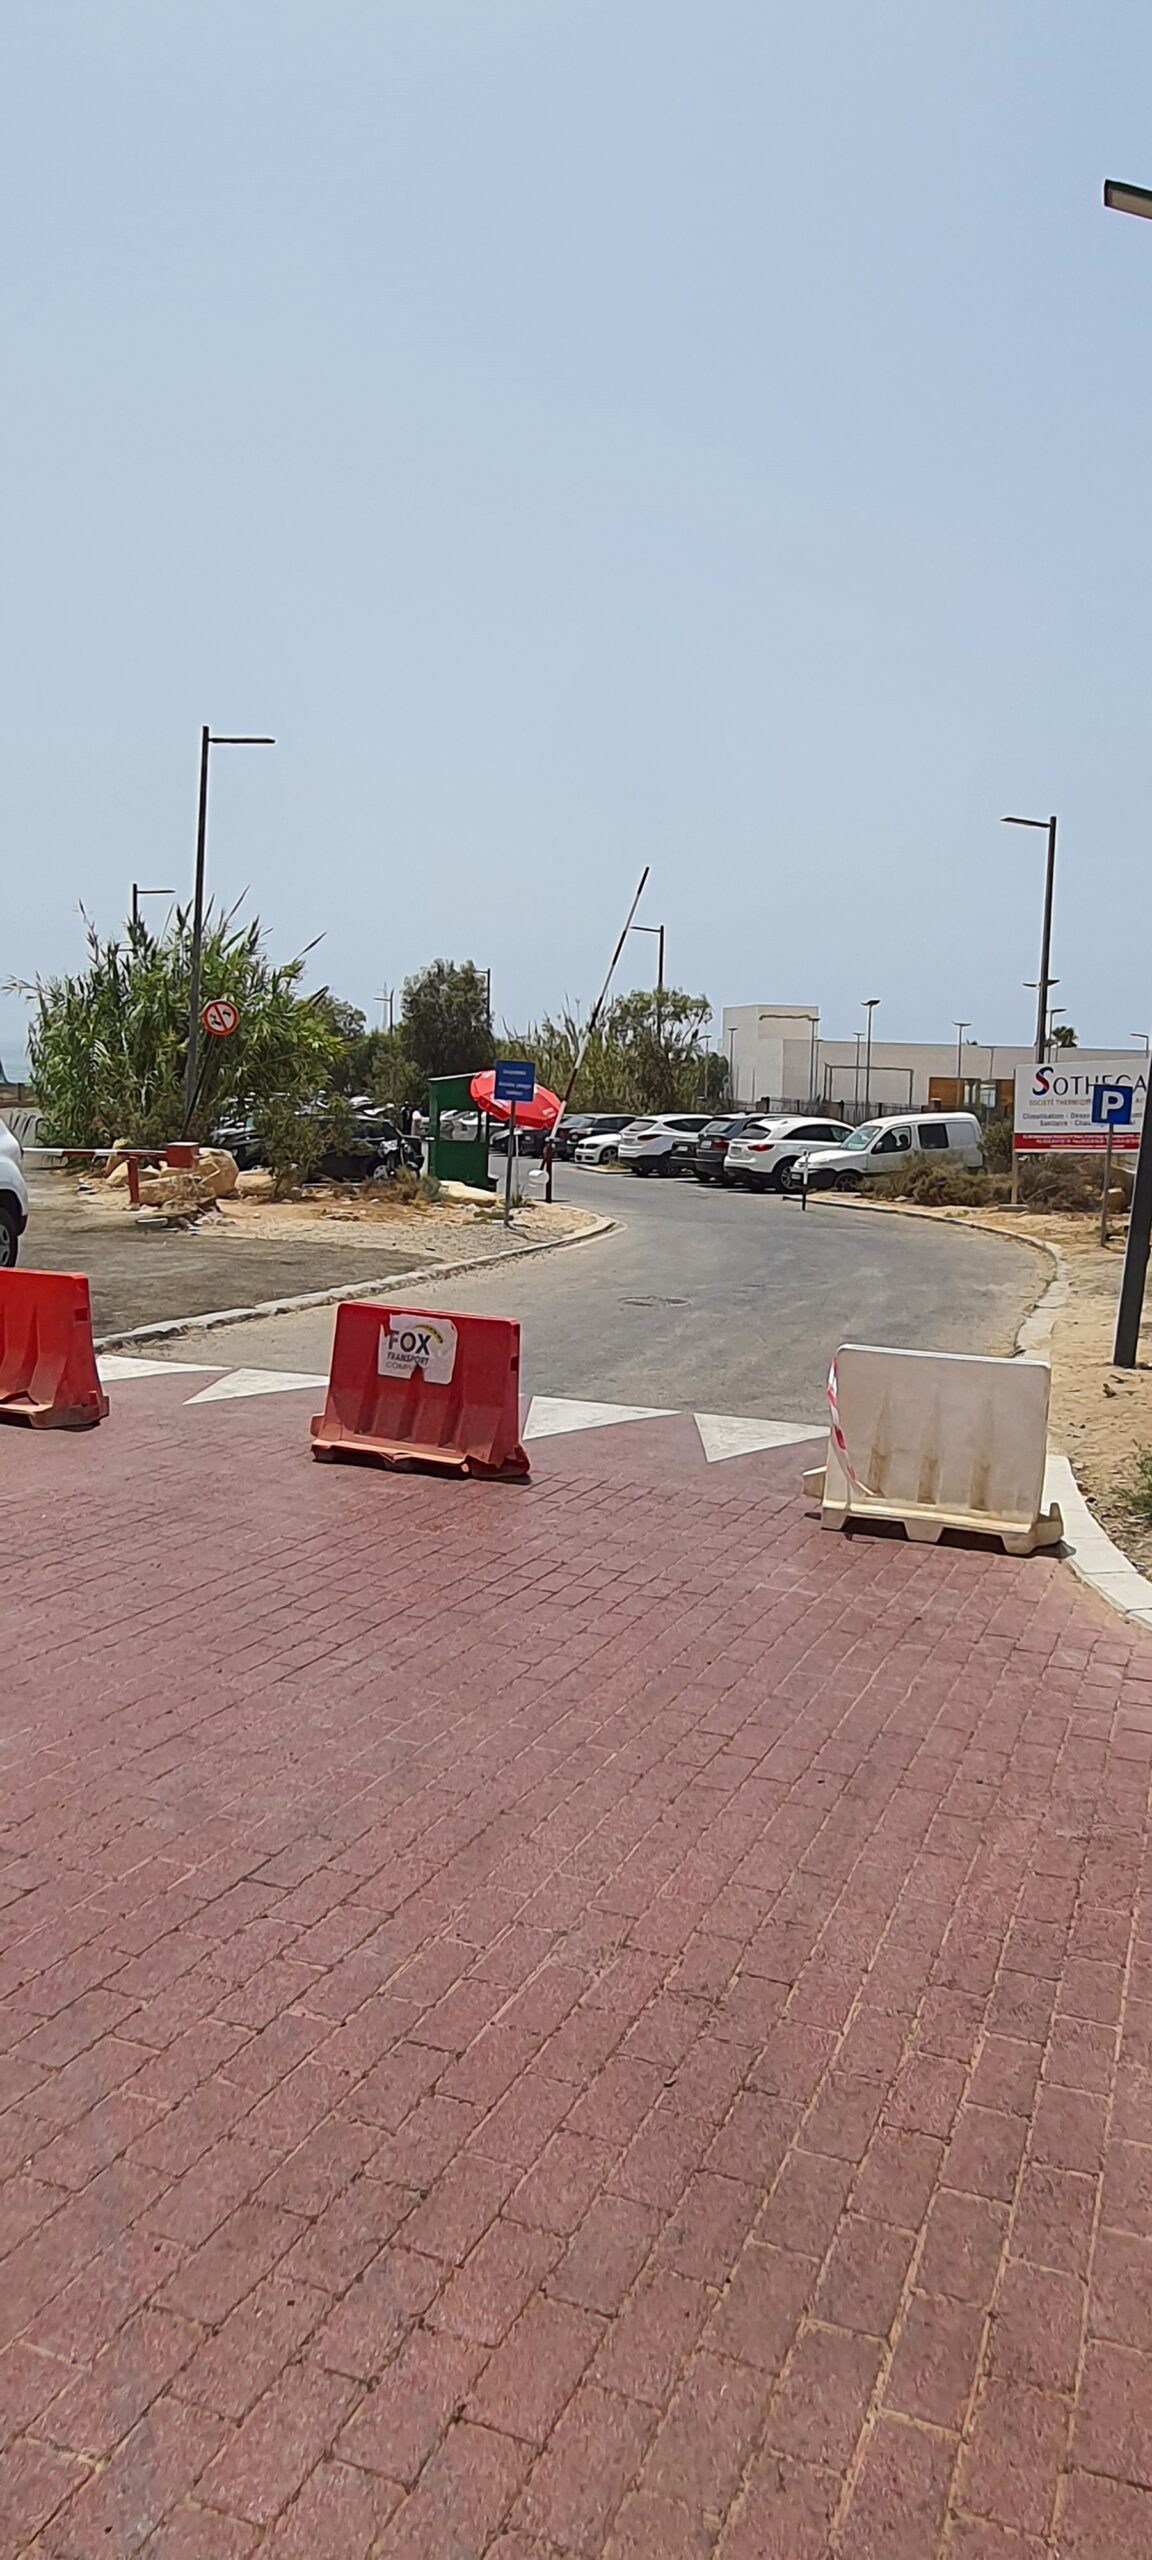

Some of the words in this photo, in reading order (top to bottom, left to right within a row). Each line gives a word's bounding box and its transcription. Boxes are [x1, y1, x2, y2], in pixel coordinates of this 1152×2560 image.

[1101, 1090, 1124, 1120] P
[388, 1329, 431, 1356] FOX
[387, 1352, 429, 1365] TRANSPORT
